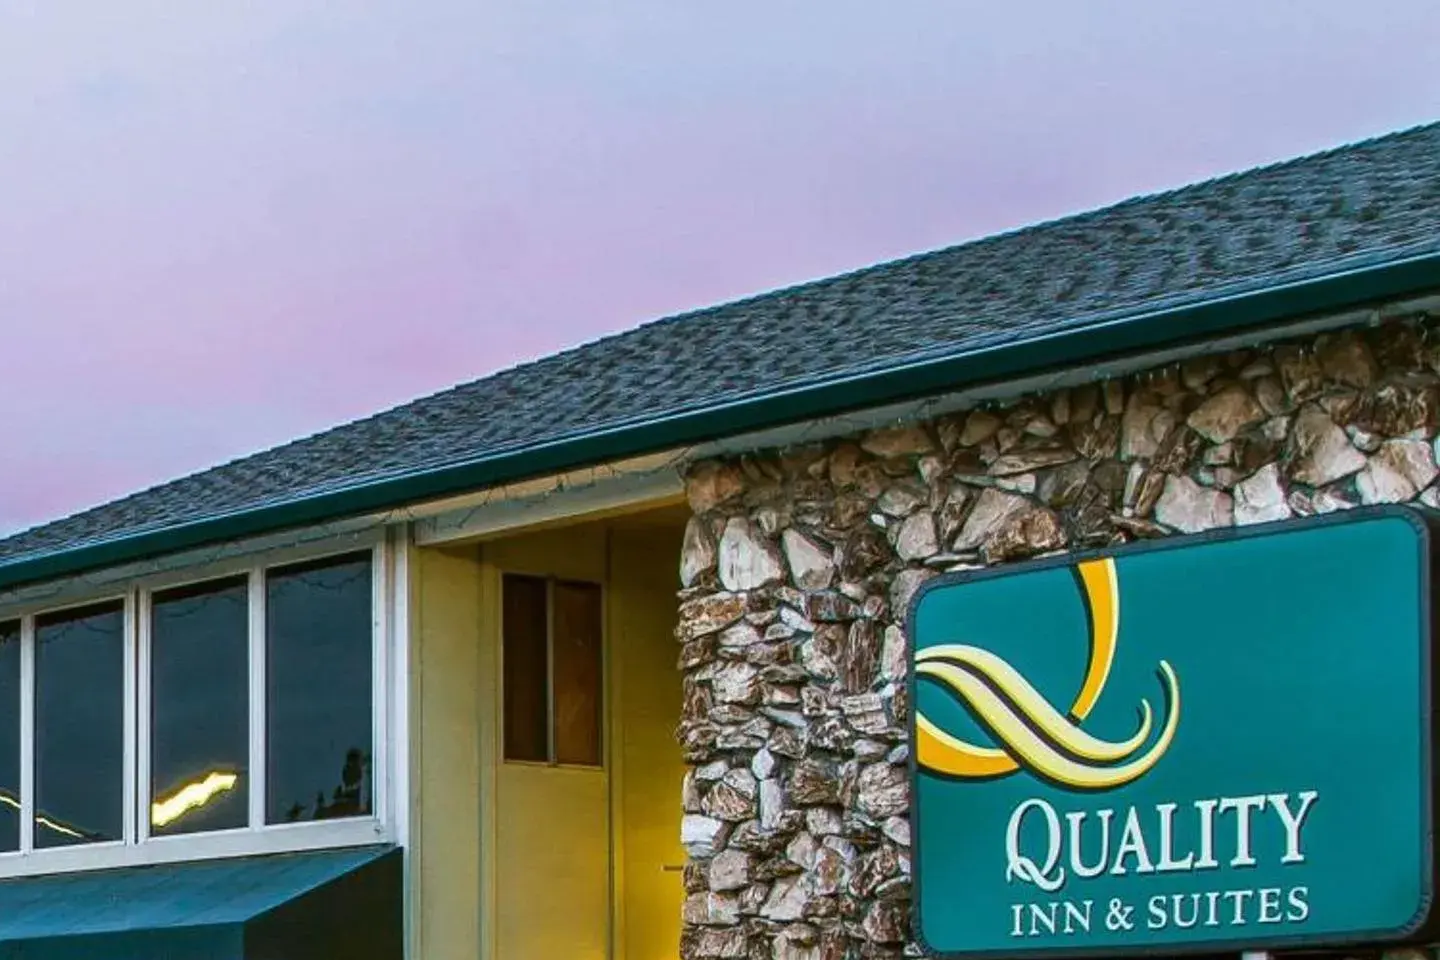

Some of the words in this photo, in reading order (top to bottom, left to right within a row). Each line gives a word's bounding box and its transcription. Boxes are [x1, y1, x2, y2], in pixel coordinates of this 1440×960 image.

[1005, 790, 1318, 892] QUALITY
[1011, 901, 1091, 936] INN
[1106, 897, 1134, 931] &
[1148, 886, 1310, 929] SUITES
